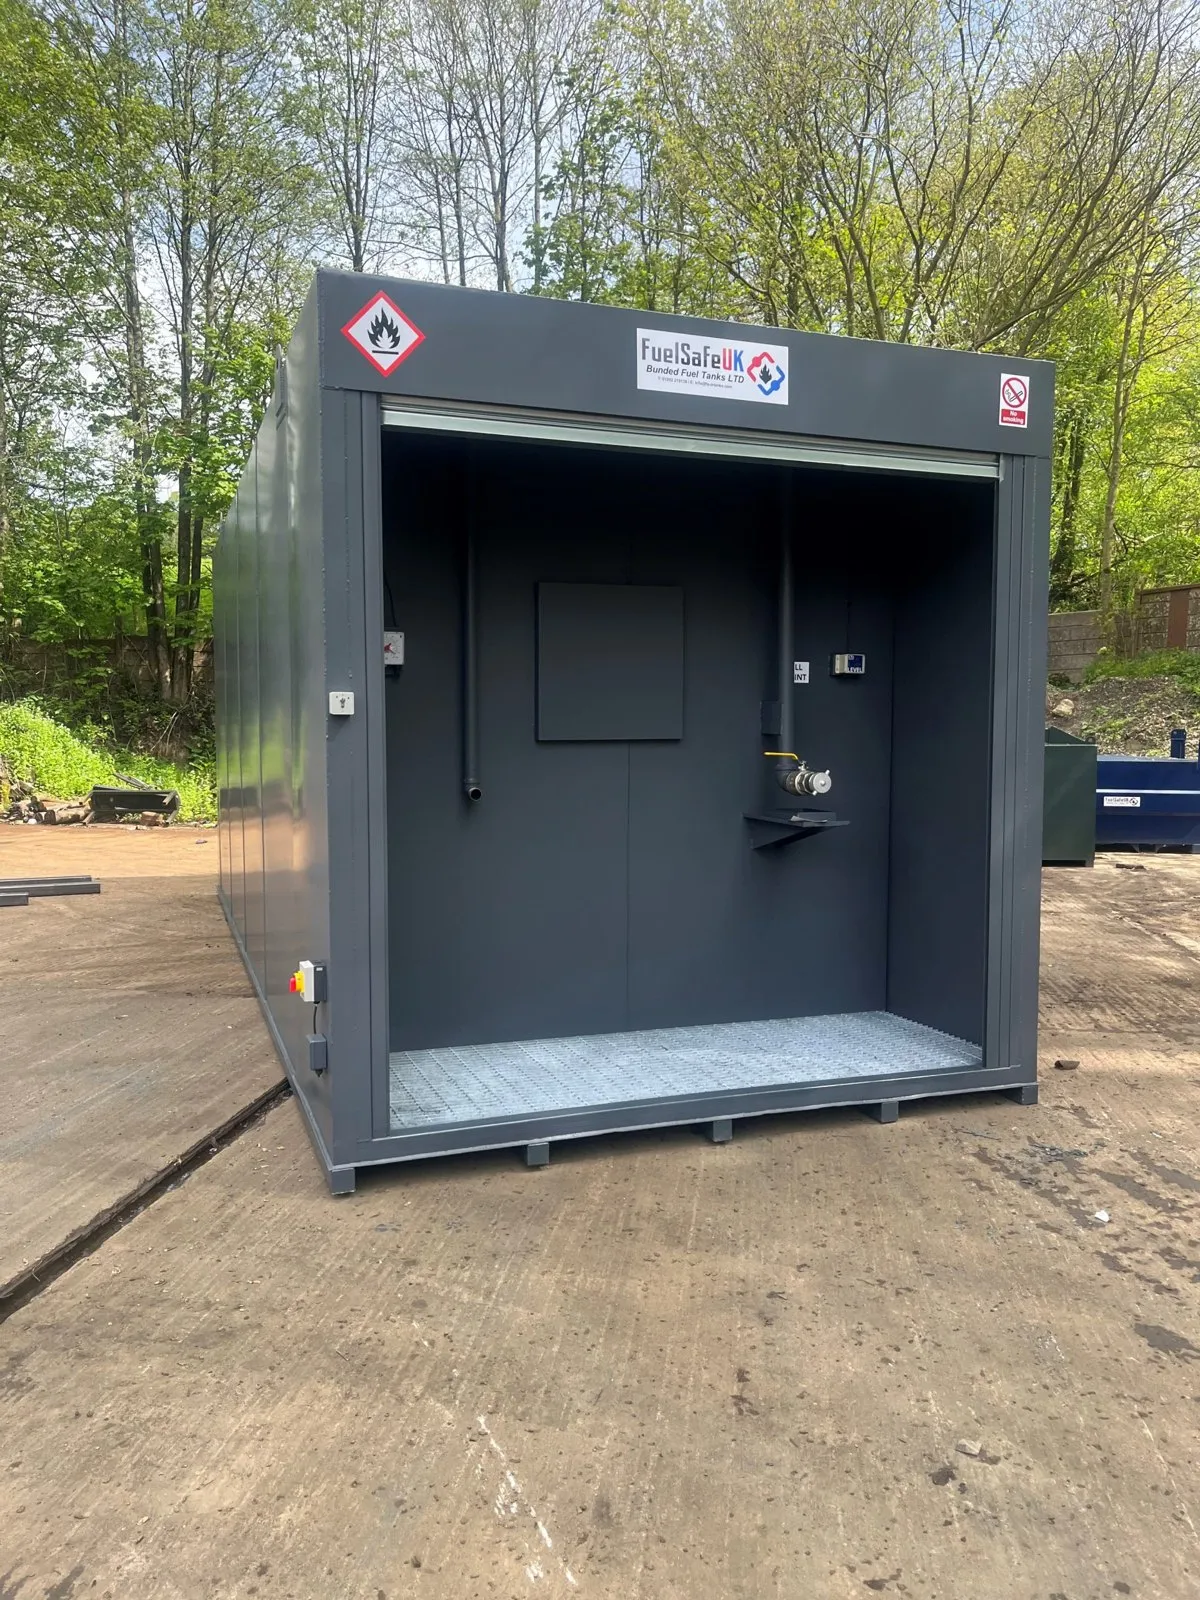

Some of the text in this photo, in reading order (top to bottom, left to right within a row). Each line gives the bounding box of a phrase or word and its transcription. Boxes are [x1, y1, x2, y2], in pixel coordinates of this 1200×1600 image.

[646, 364, 681, 376] Bunded
[681, 368, 699, 378] Fuel
[701, 371, 726, 382] Tanks
[727, 374, 745, 384] LTD
[794, 663, 803, 671] LL
[794, 673, 807, 681] INT
